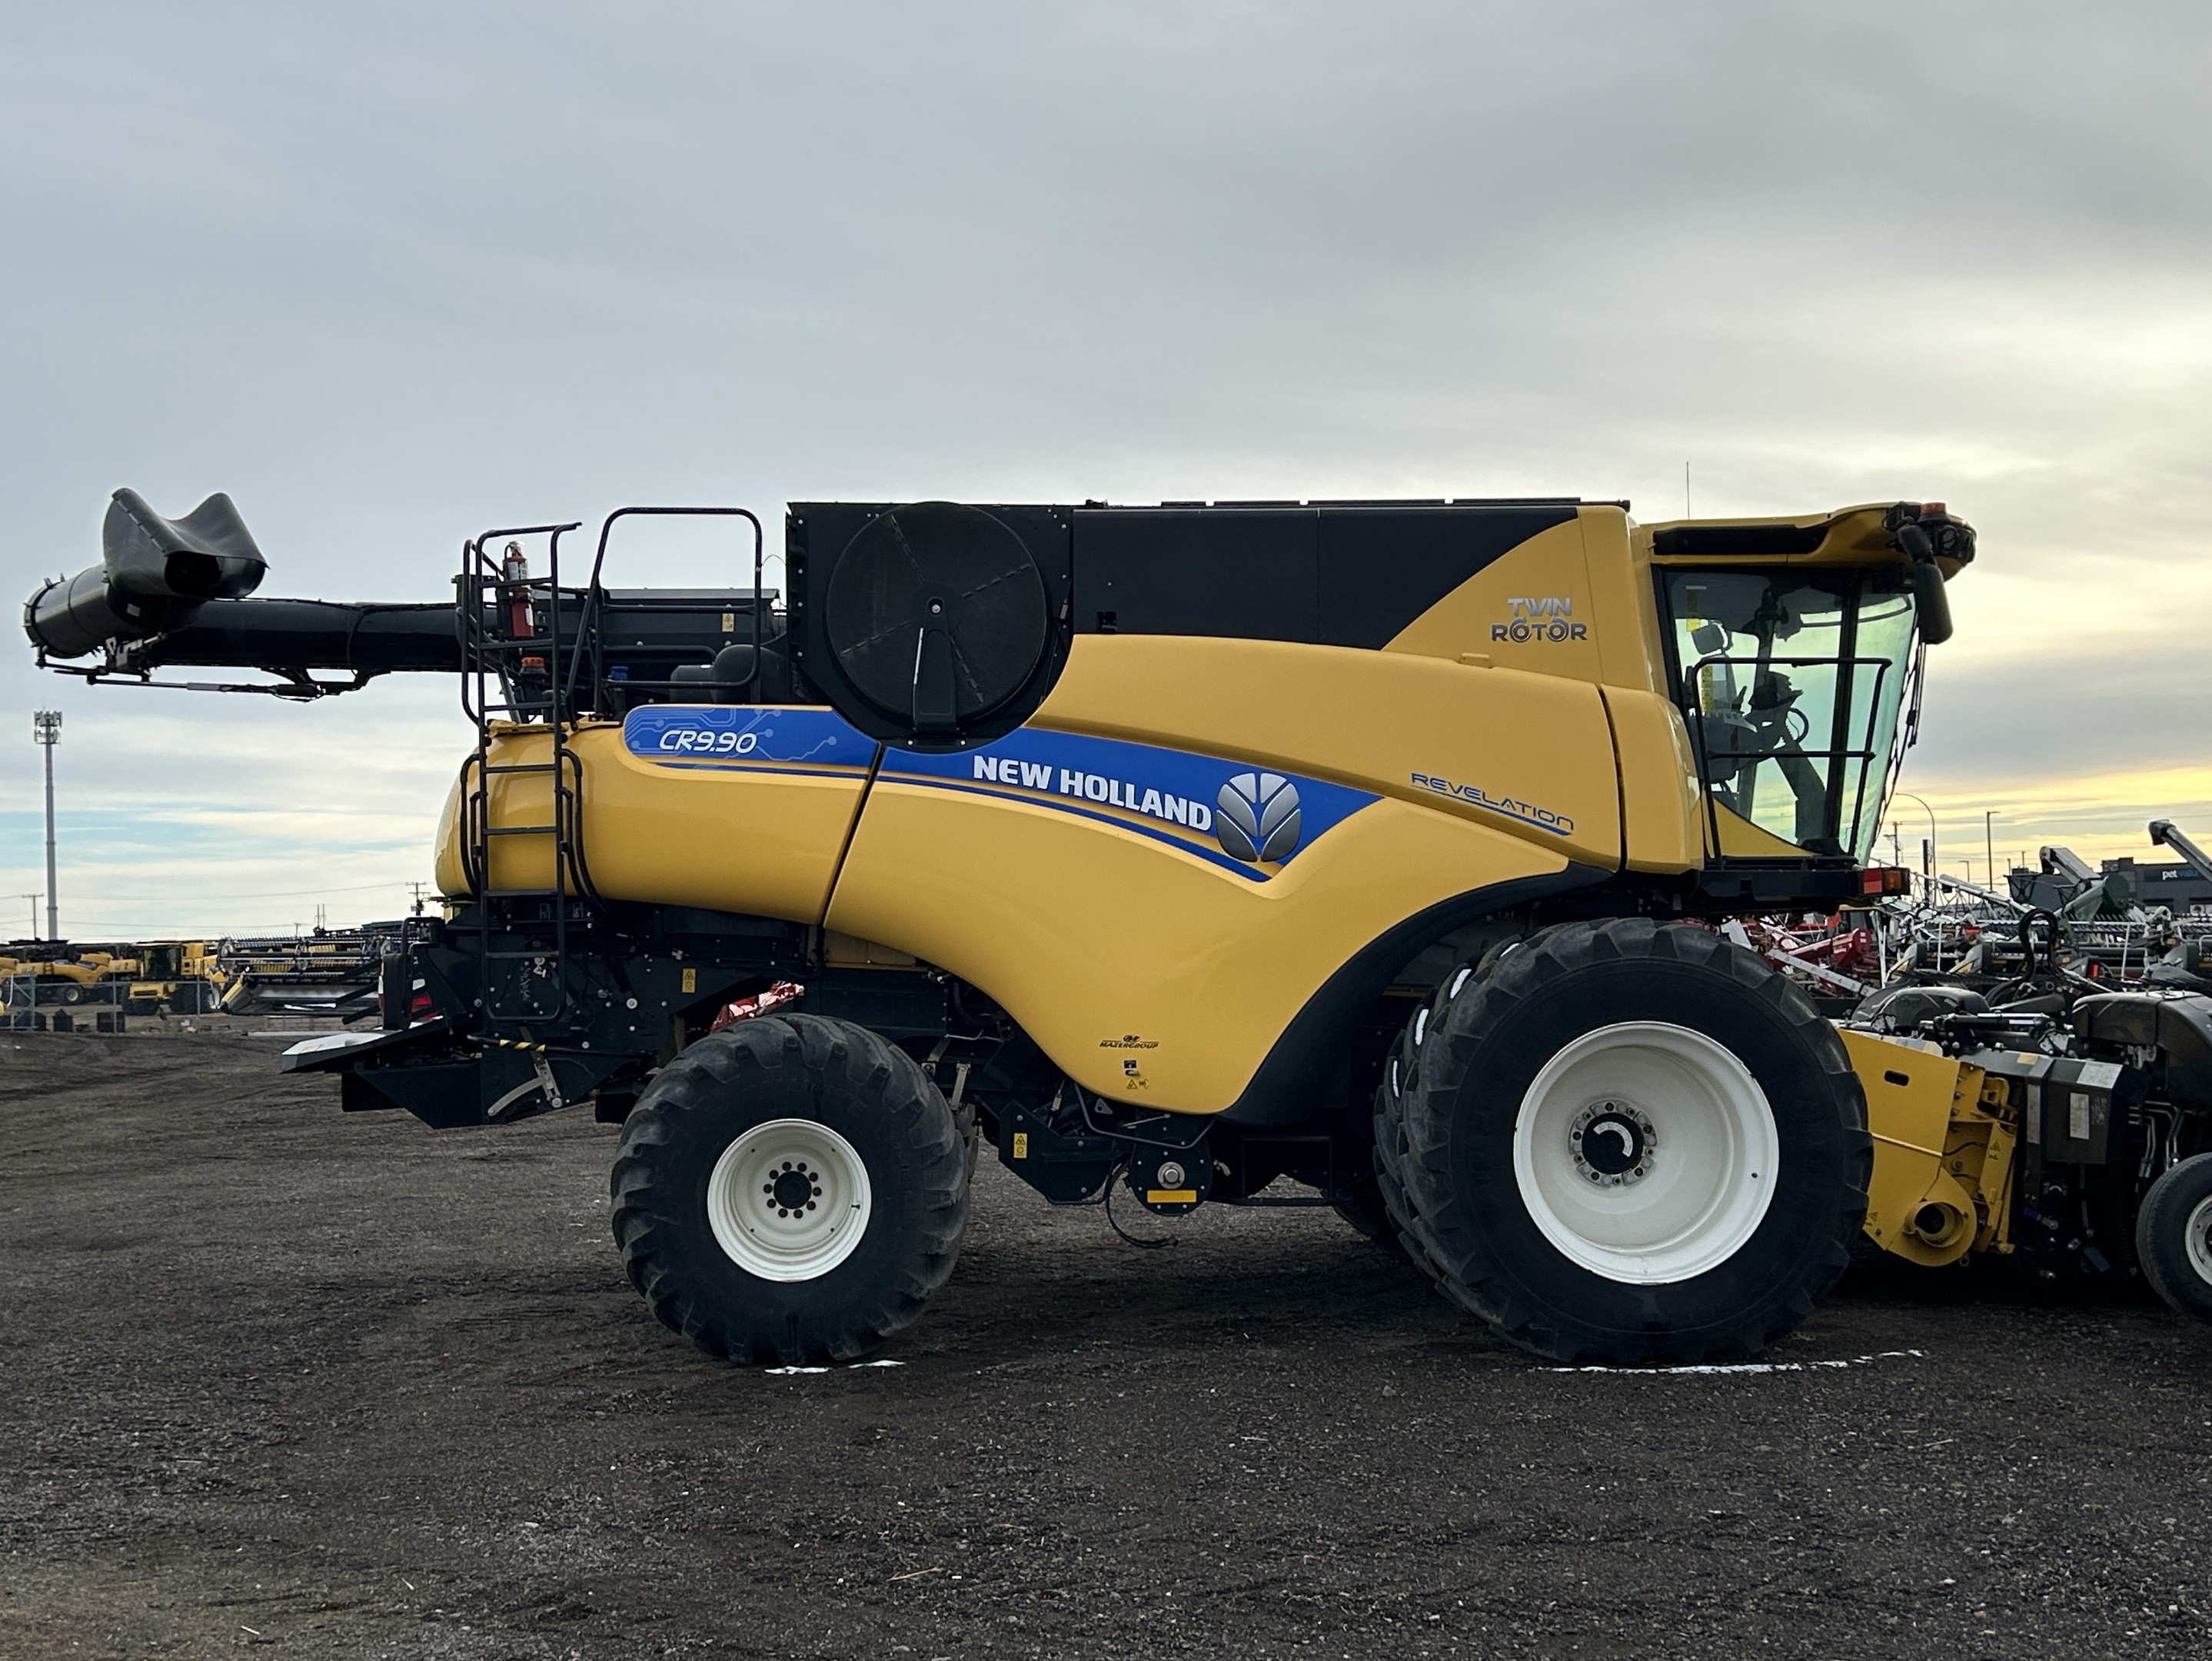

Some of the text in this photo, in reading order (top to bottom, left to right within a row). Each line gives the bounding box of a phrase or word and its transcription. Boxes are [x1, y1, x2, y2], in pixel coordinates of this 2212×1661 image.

[1508, 597, 1572, 616] TWIN
[1490, 617, 1588, 643] ROTOR
[659, 730, 757, 754] CR9.90
[973, 754, 1212, 831] NEW HOLLAND
[1410, 772, 1575, 831] REVELATION
[2161, 870, 2178, 880] pet
